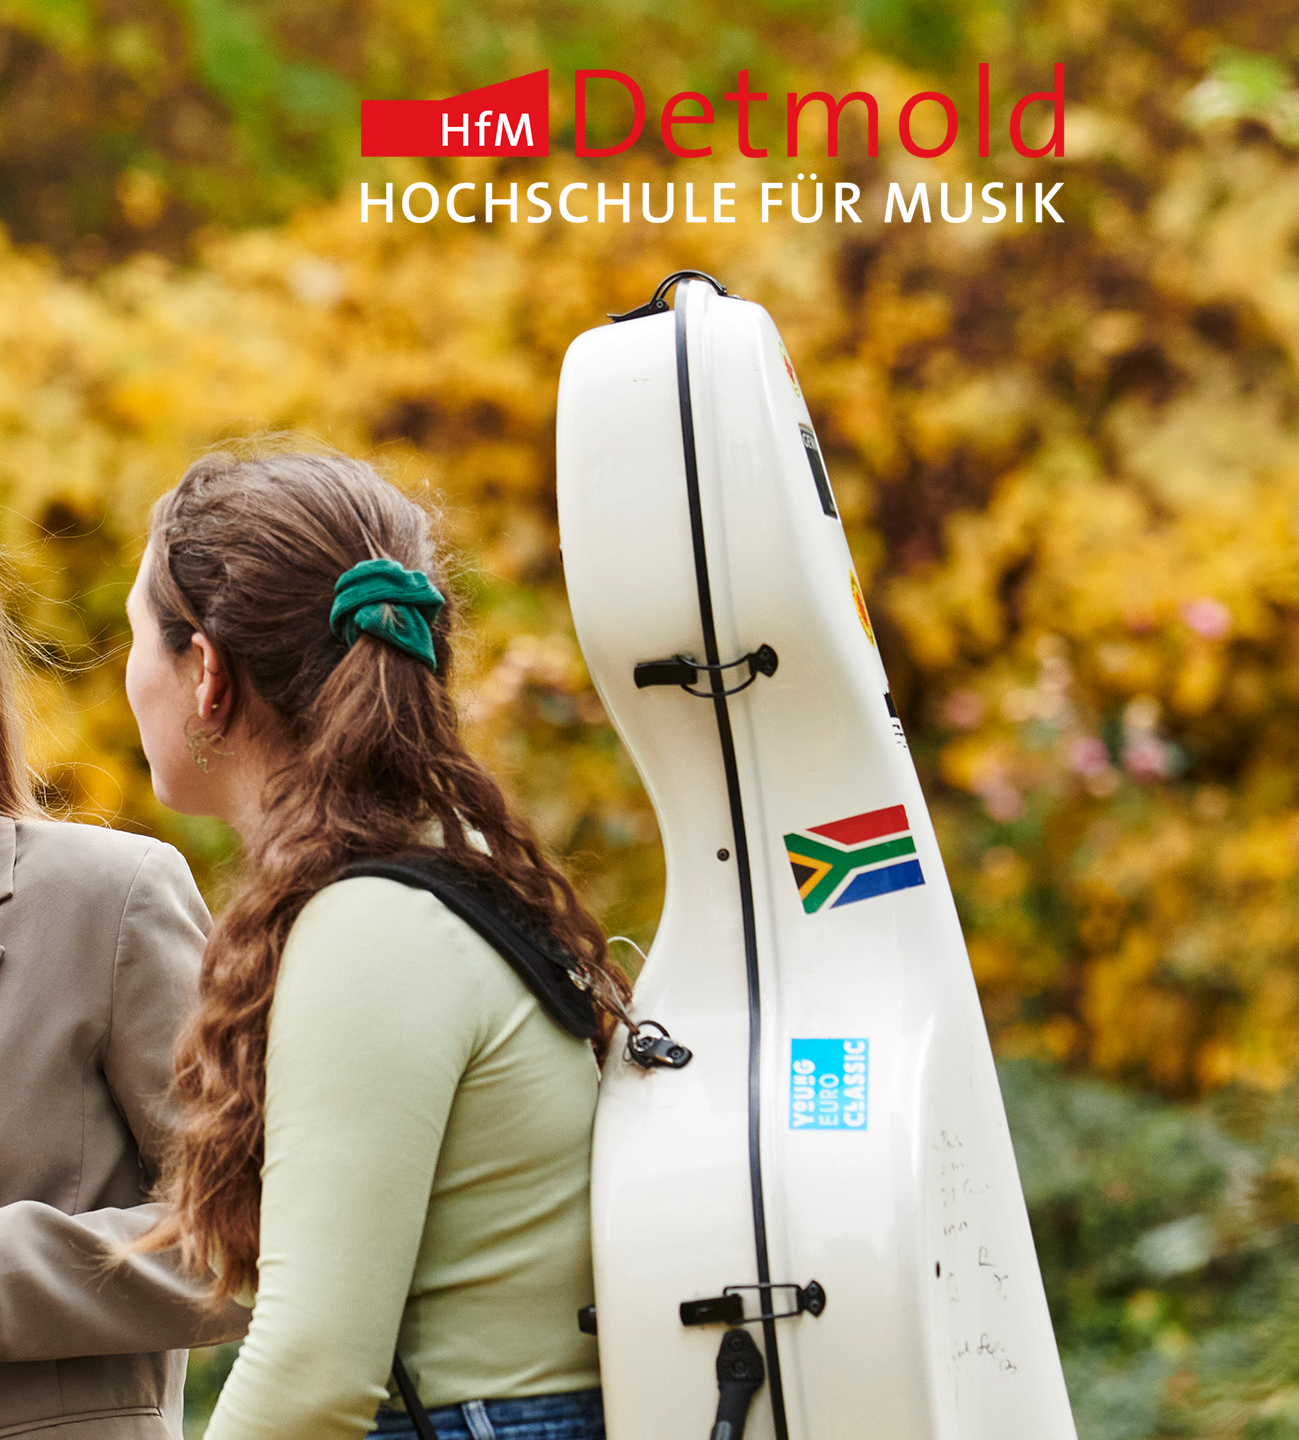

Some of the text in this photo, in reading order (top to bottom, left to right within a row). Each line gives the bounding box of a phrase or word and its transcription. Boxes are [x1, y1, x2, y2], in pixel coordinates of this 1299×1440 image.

[792, 1058, 816, 1128] YOUNG
[818, 1073, 840, 1126] EURO
[843, 1040, 866, 1127] CLASSIC
